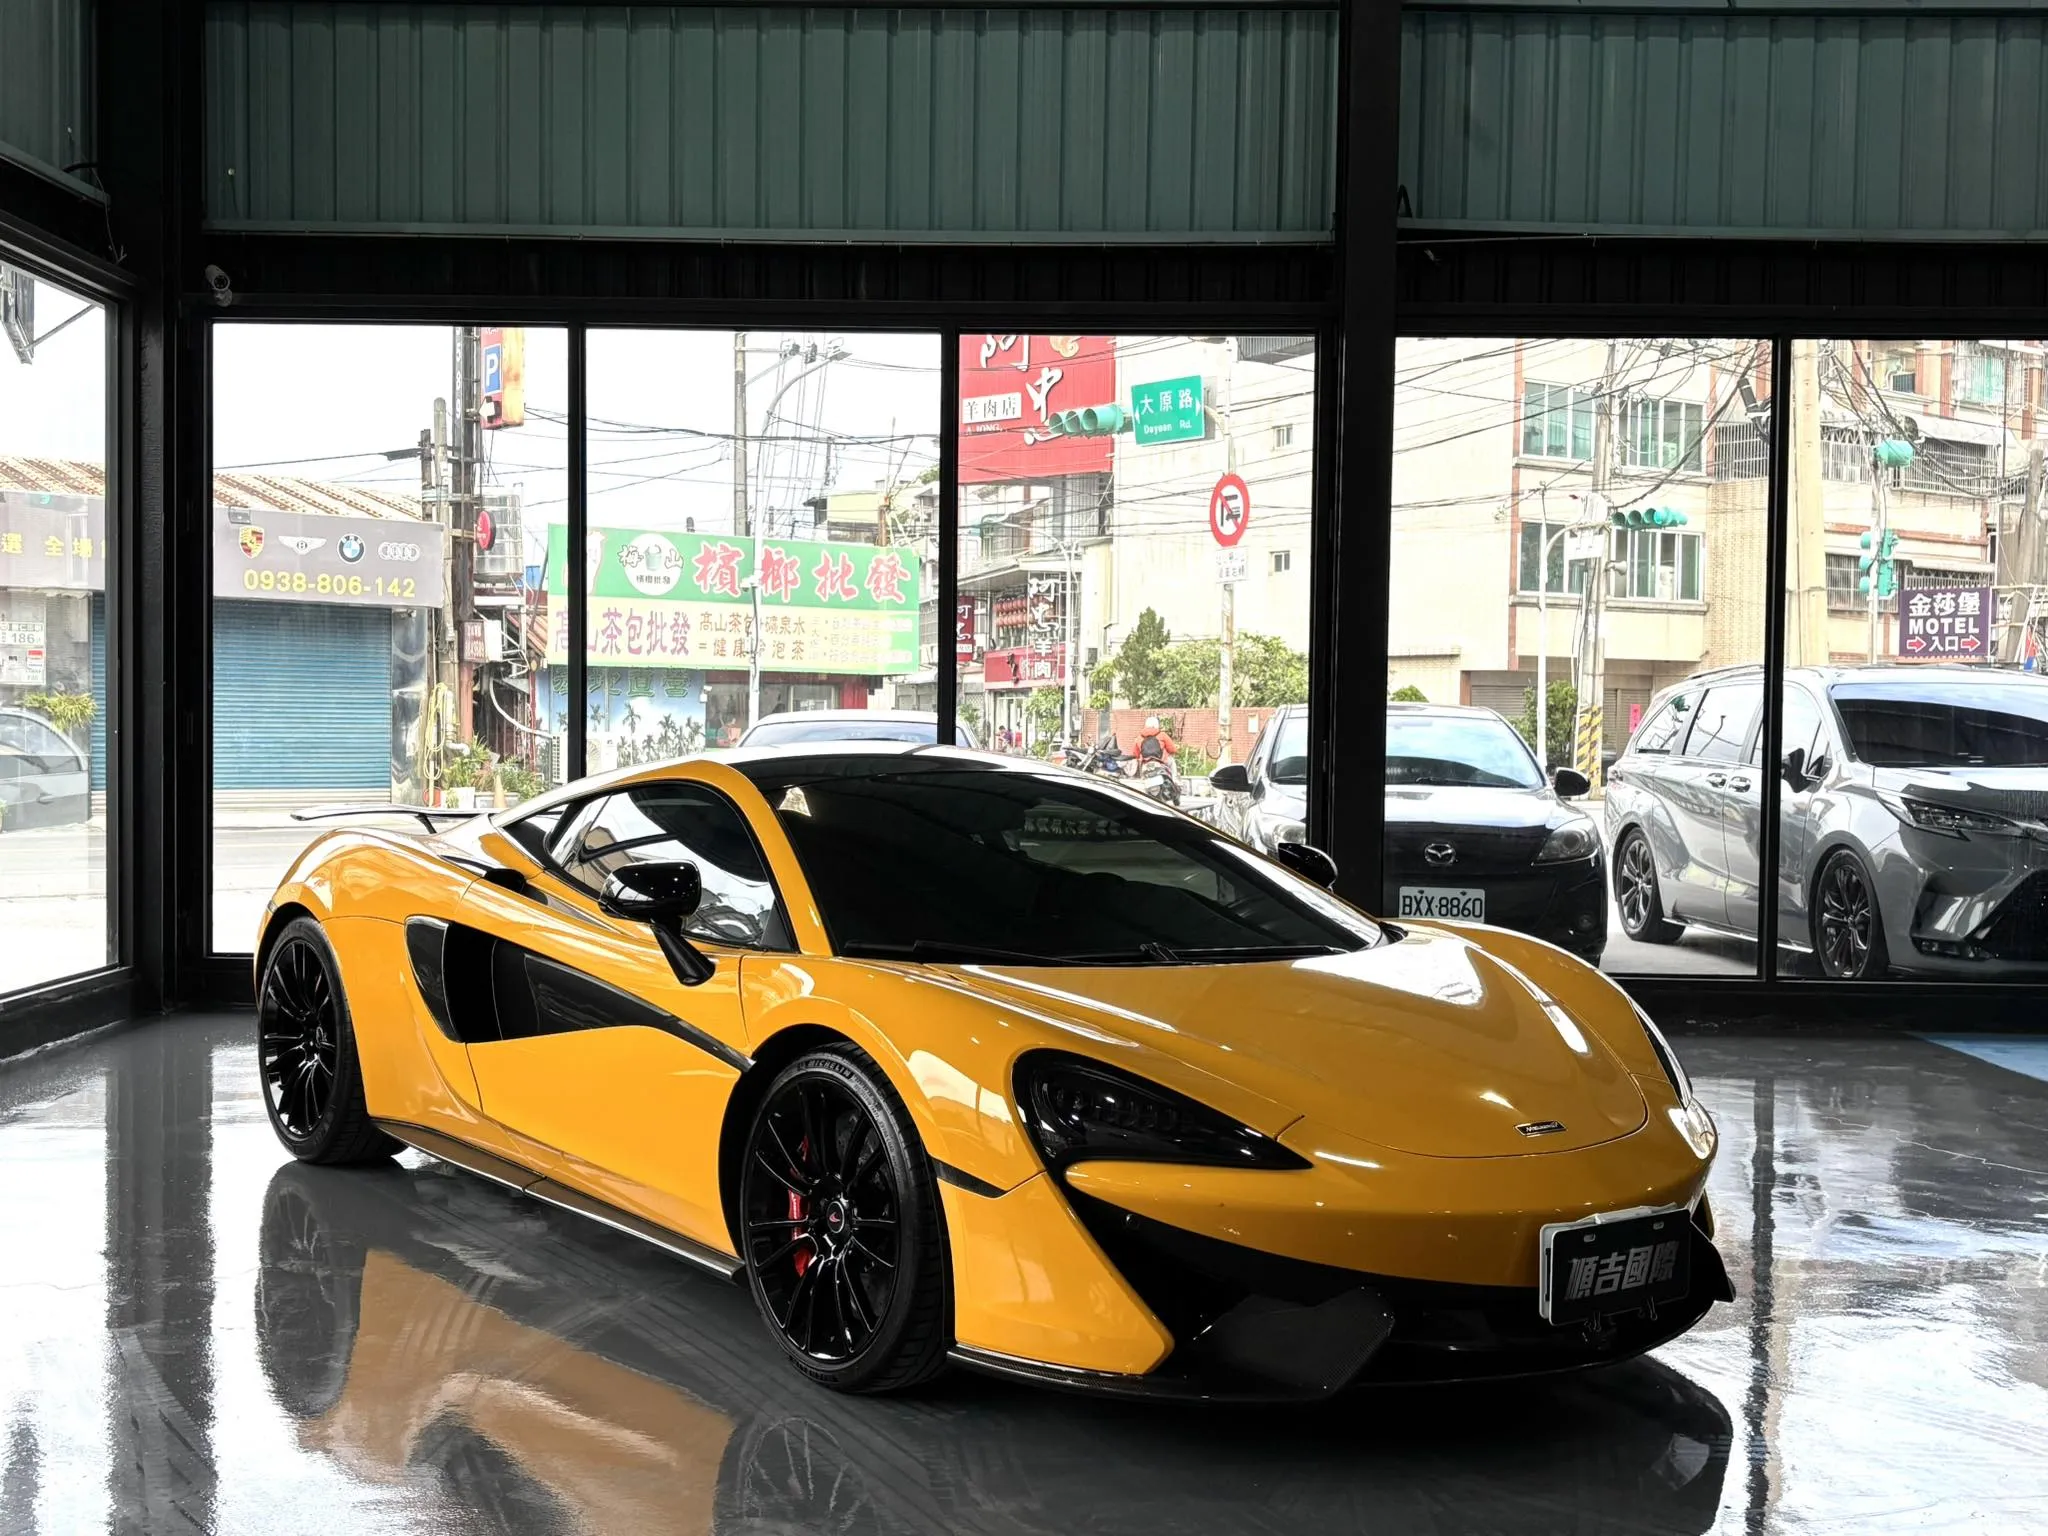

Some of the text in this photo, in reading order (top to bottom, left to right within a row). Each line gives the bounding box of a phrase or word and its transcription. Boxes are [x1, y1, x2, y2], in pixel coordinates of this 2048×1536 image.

[485, 353, 499, 388] P
[966, 397, 1017, 421] 羊肉店
[1139, 388, 1193, 416] 大原路
[1143, 423, 1173, 435] Dayuan
[1, 533, 106, 559] 選 全場
[617, 544, 685, 569] 梅山
[243, 568, 416, 598] 0938-806-142
[693, 541, 912, 604] 檳榔批發
[1908, 591, 1980, 617] 金莎堡
[1027, 577, 1060, 679] 阿忠羊肉
[1909, 617, 1979, 635] MOTEL
[1929, 636, 1959, 652] 入口
[807, 1059, 852, 1077] MICHELIN
[1565, 1240, 1680, 1300] 順吉國際
